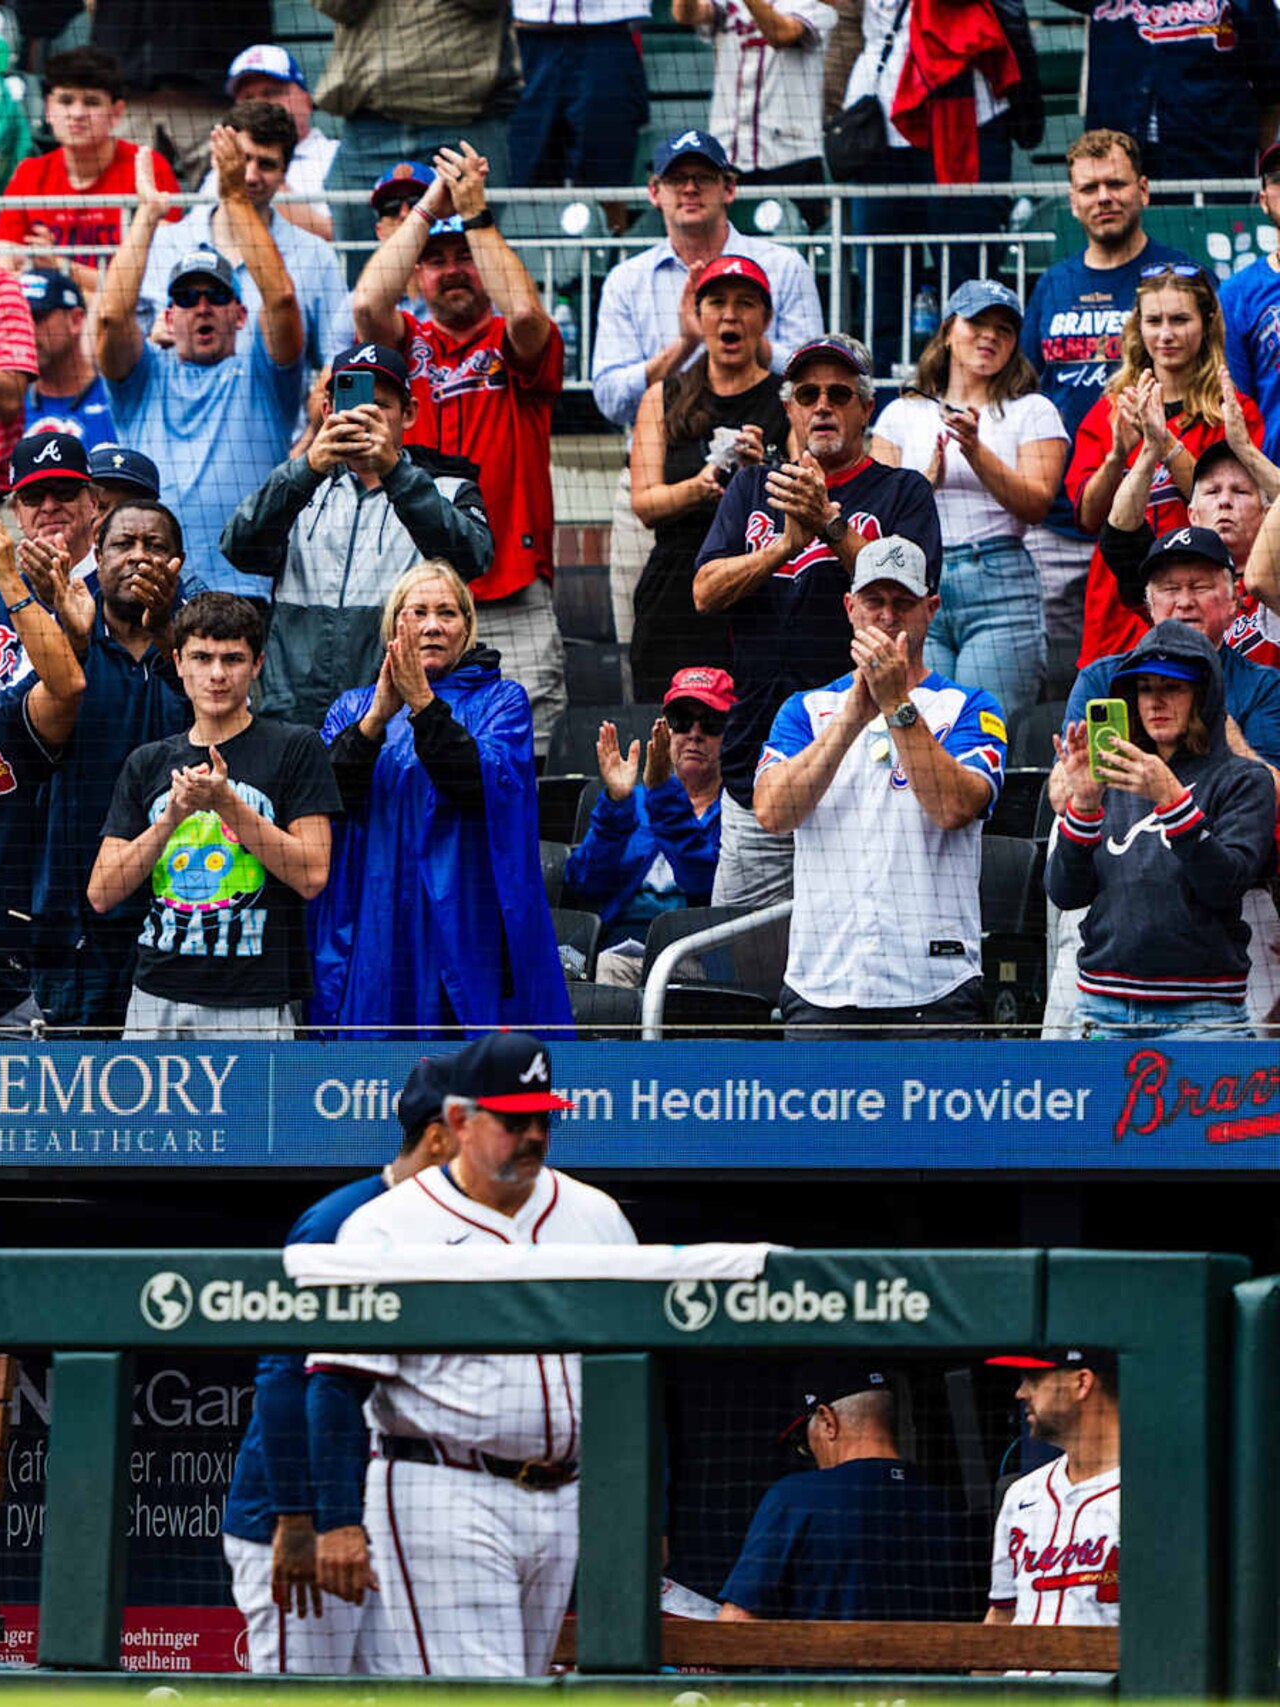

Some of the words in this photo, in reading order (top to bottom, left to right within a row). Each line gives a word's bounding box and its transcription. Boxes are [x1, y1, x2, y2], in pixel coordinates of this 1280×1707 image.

[349, 344, 377, 364] A
[32, 439, 62, 464] A
[1163, 527, 1192, 549] A
[875, 545, 905, 568] A
[519, 1051, 548, 1083] A
[632, 1079, 886, 1121] Healthcare
[902, 1079, 1091, 1121] Provider
[198, 1279, 319, 1323] Globe
[326, 1283, 402, 1322] Life
[724, 1279, 846, 1323] Globe
[854, 1277, 930, 1322] Life
[1008, 1527, 1108, 1579] Braves
[121, 1627, 200, 1649] oehringer
[120, 1651, 191, 1672] ngelheim
